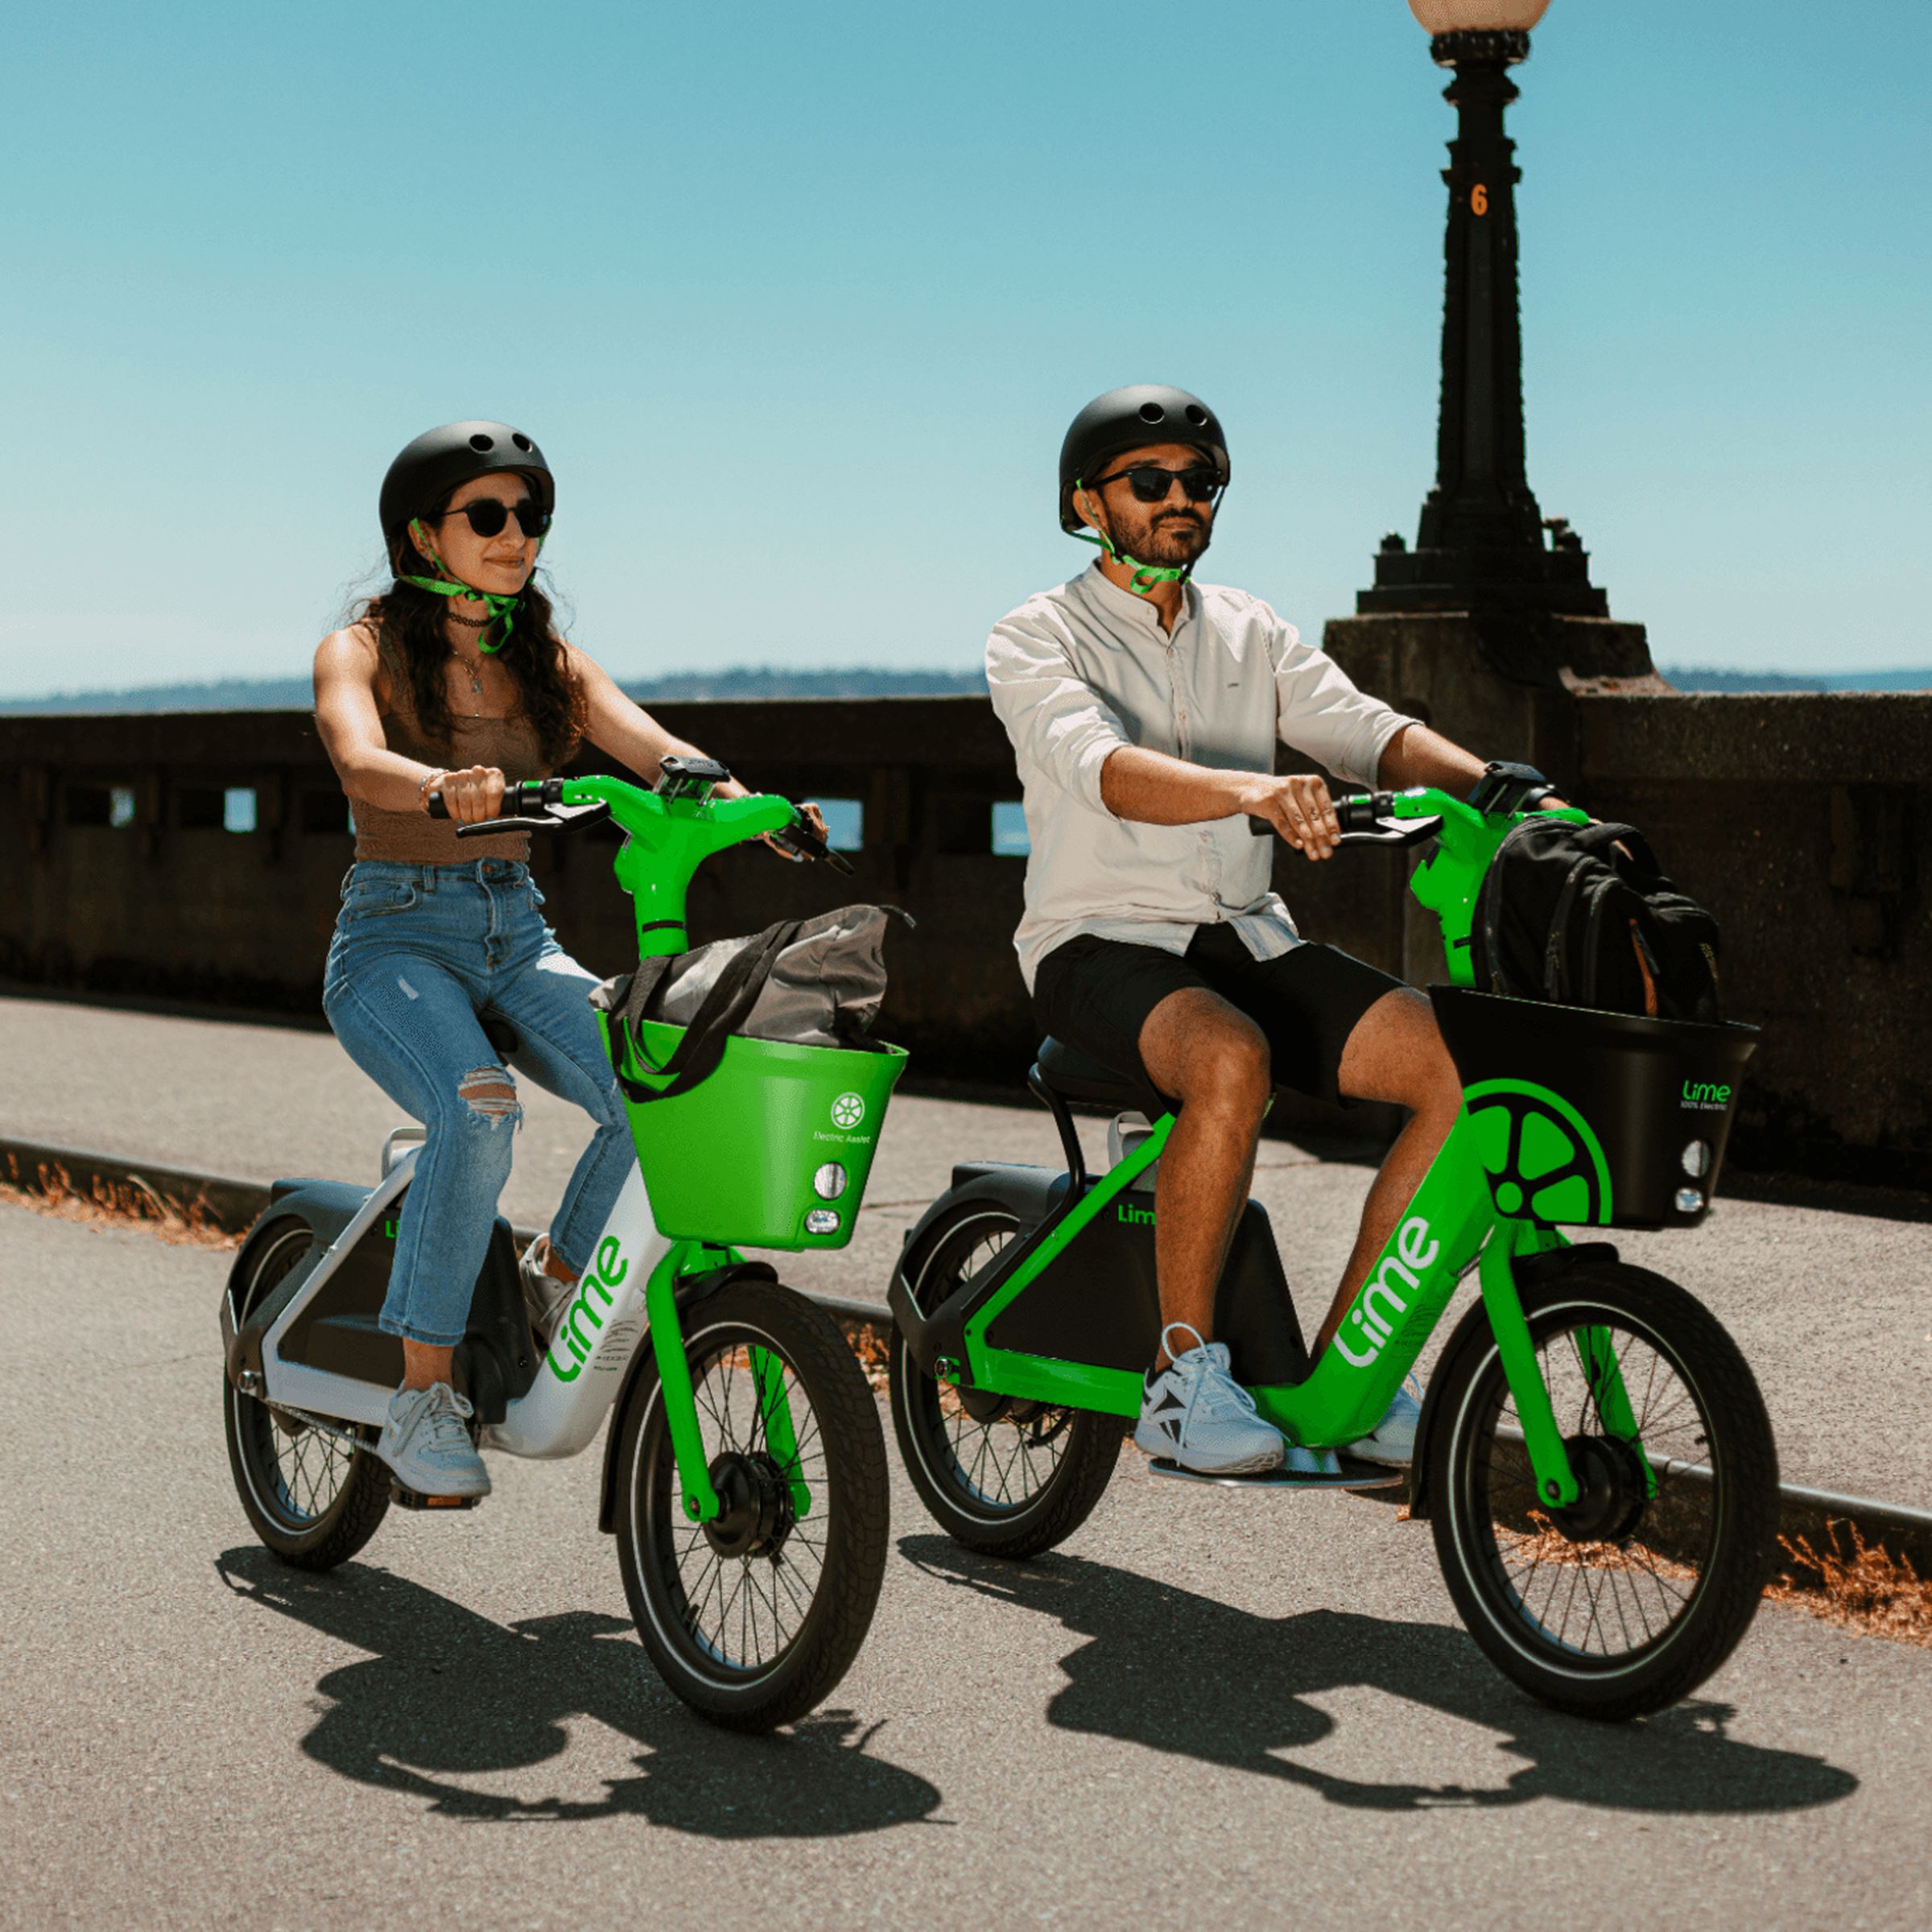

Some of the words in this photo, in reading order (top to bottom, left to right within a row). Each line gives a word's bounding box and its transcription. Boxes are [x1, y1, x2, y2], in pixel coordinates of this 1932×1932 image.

[1470, 184, 1488, 217] 6
[1682, 1080, 1732, 1102] Lime
[385, 1218, 401, 1238] Li
[1117, 1203, 1157, 1226] Lim
[1333, 1216, 1440, 1368] Lime
[547, 1235, 629, 1382] Lime
